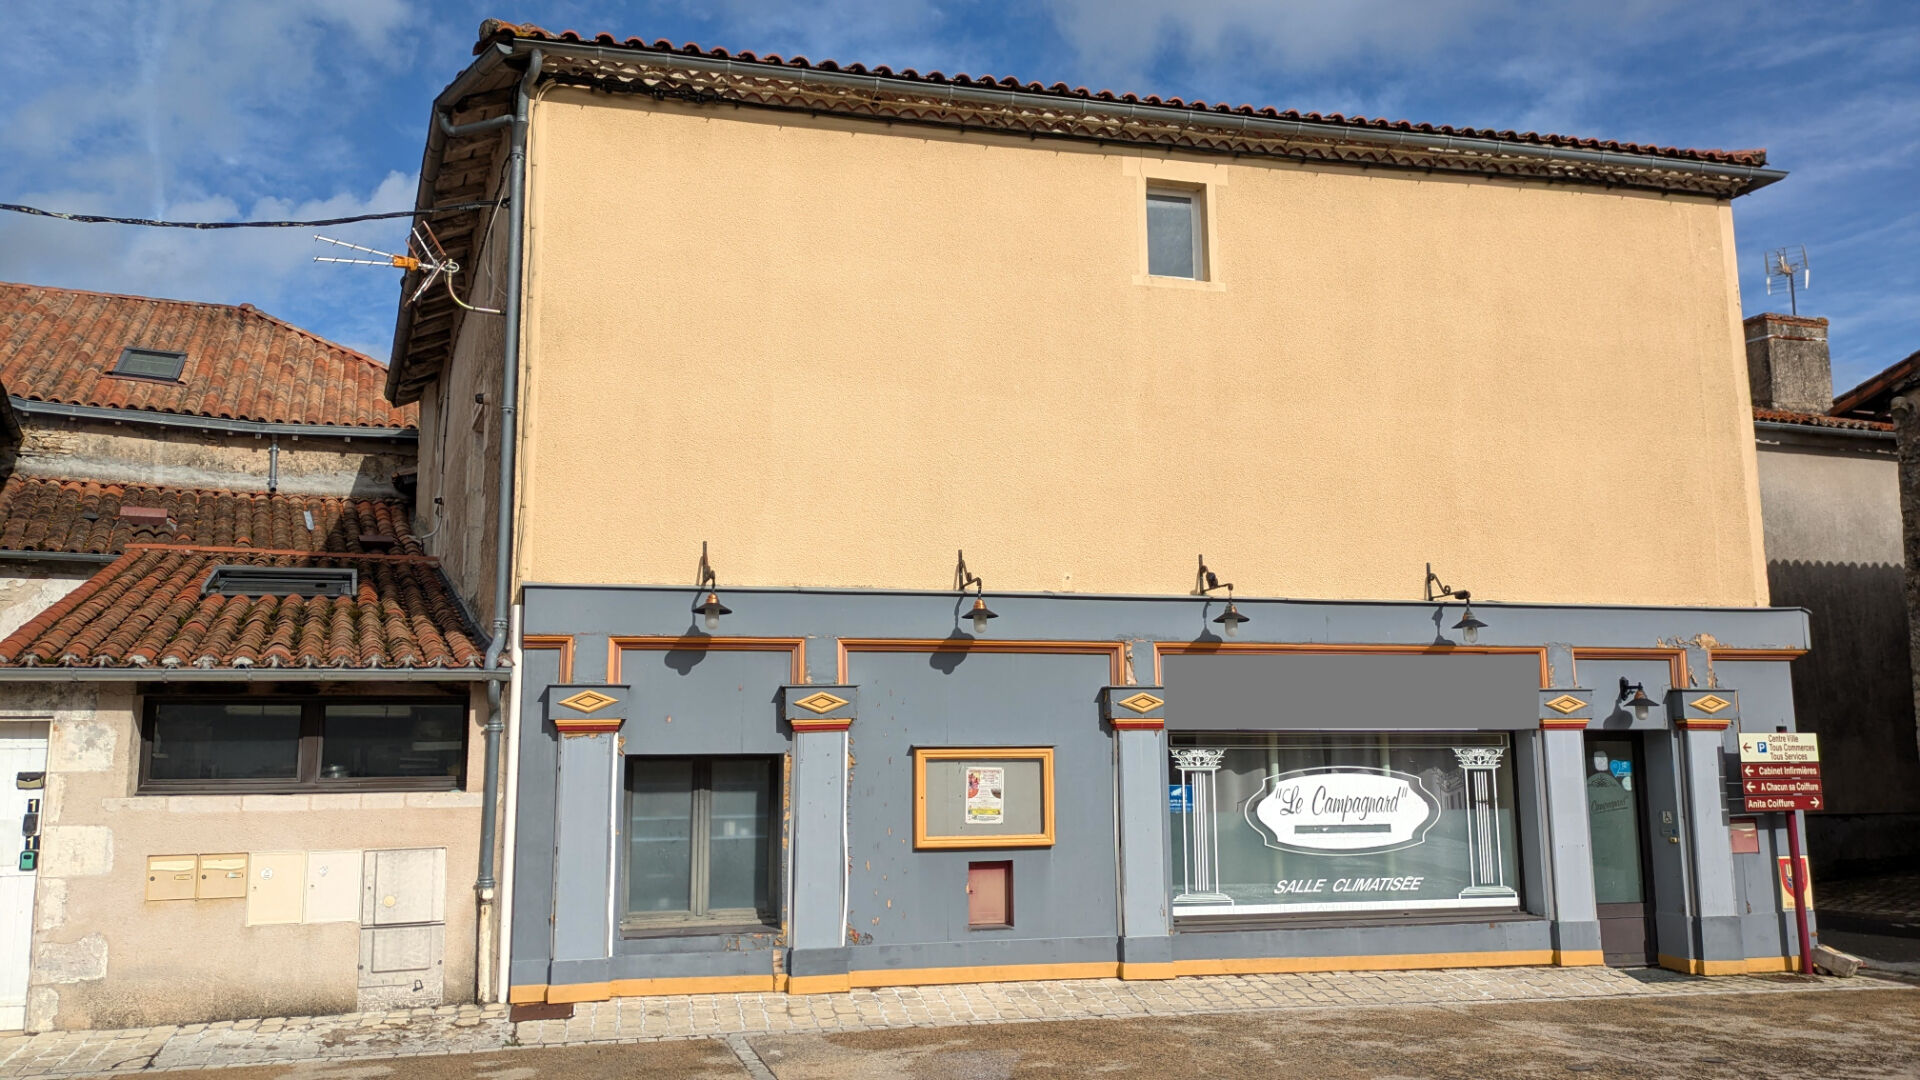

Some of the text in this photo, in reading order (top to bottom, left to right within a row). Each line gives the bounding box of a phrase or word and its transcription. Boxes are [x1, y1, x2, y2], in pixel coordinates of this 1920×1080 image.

[1759, 767, 1817, 775] Cabinet Infirmières
[1766, 782, 1788, 791] Chacun
[1796, 782, 1818, 791] Coiffure
[1748, 799, 1795, 808] Anita Coiffure
[1274, 878, 1327, 894] SALLE
